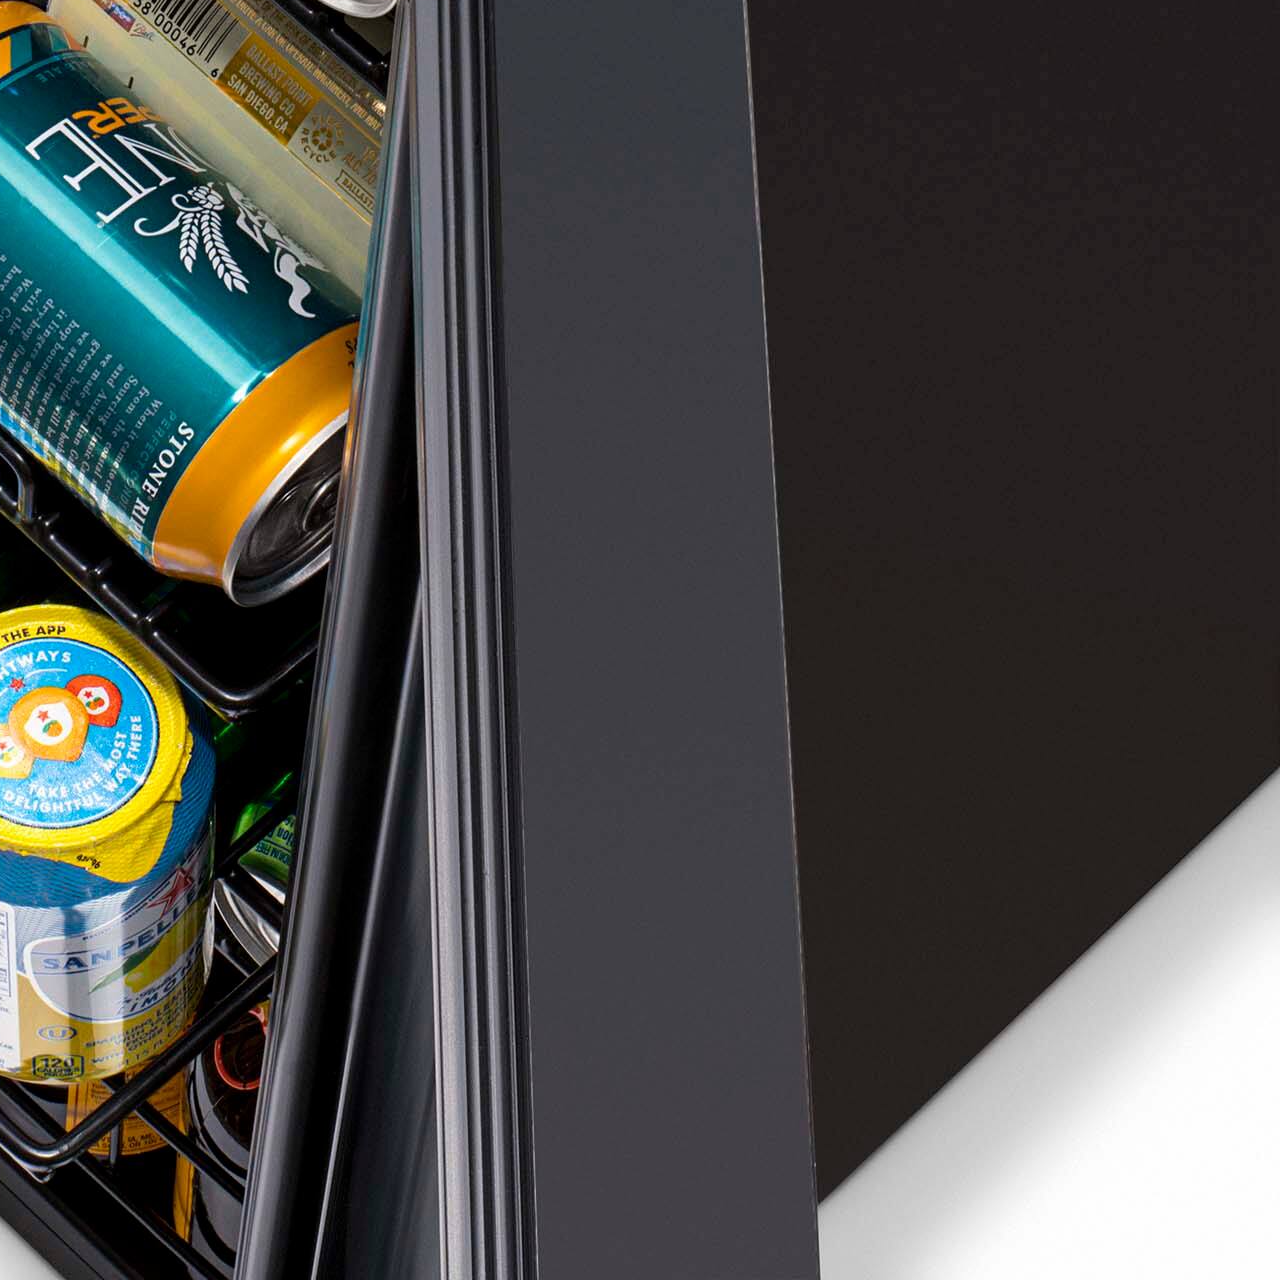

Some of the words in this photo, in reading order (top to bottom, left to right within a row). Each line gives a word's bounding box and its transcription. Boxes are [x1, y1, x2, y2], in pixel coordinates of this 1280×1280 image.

[152, 12, 199, 57] 00046
[226, 73, 249, 97] SAN
[243, 89, 279, 124] DIEGO,
[273, 117, 289, 134] CA
[237, 62, 282, 105] BREWING
[277, 98, 298, 119] CO.
[245, 43, 285, 82] BALLAST
[281, 75, 313, 106] POINT
[138, 420, 196, 498] STONE
[2, 626, 31, 643] THE
[36, 626, 66, 636] APP
[4, 789, 105, 813] DELIGHTFUL
[105, 763, 131, 793] WAY
[127, 715, 142, 759] THERE
[28, 783, 68, 798] TAKE
[74, 772, 103, 793] THE
[102, 732, 127, 771] MOST
